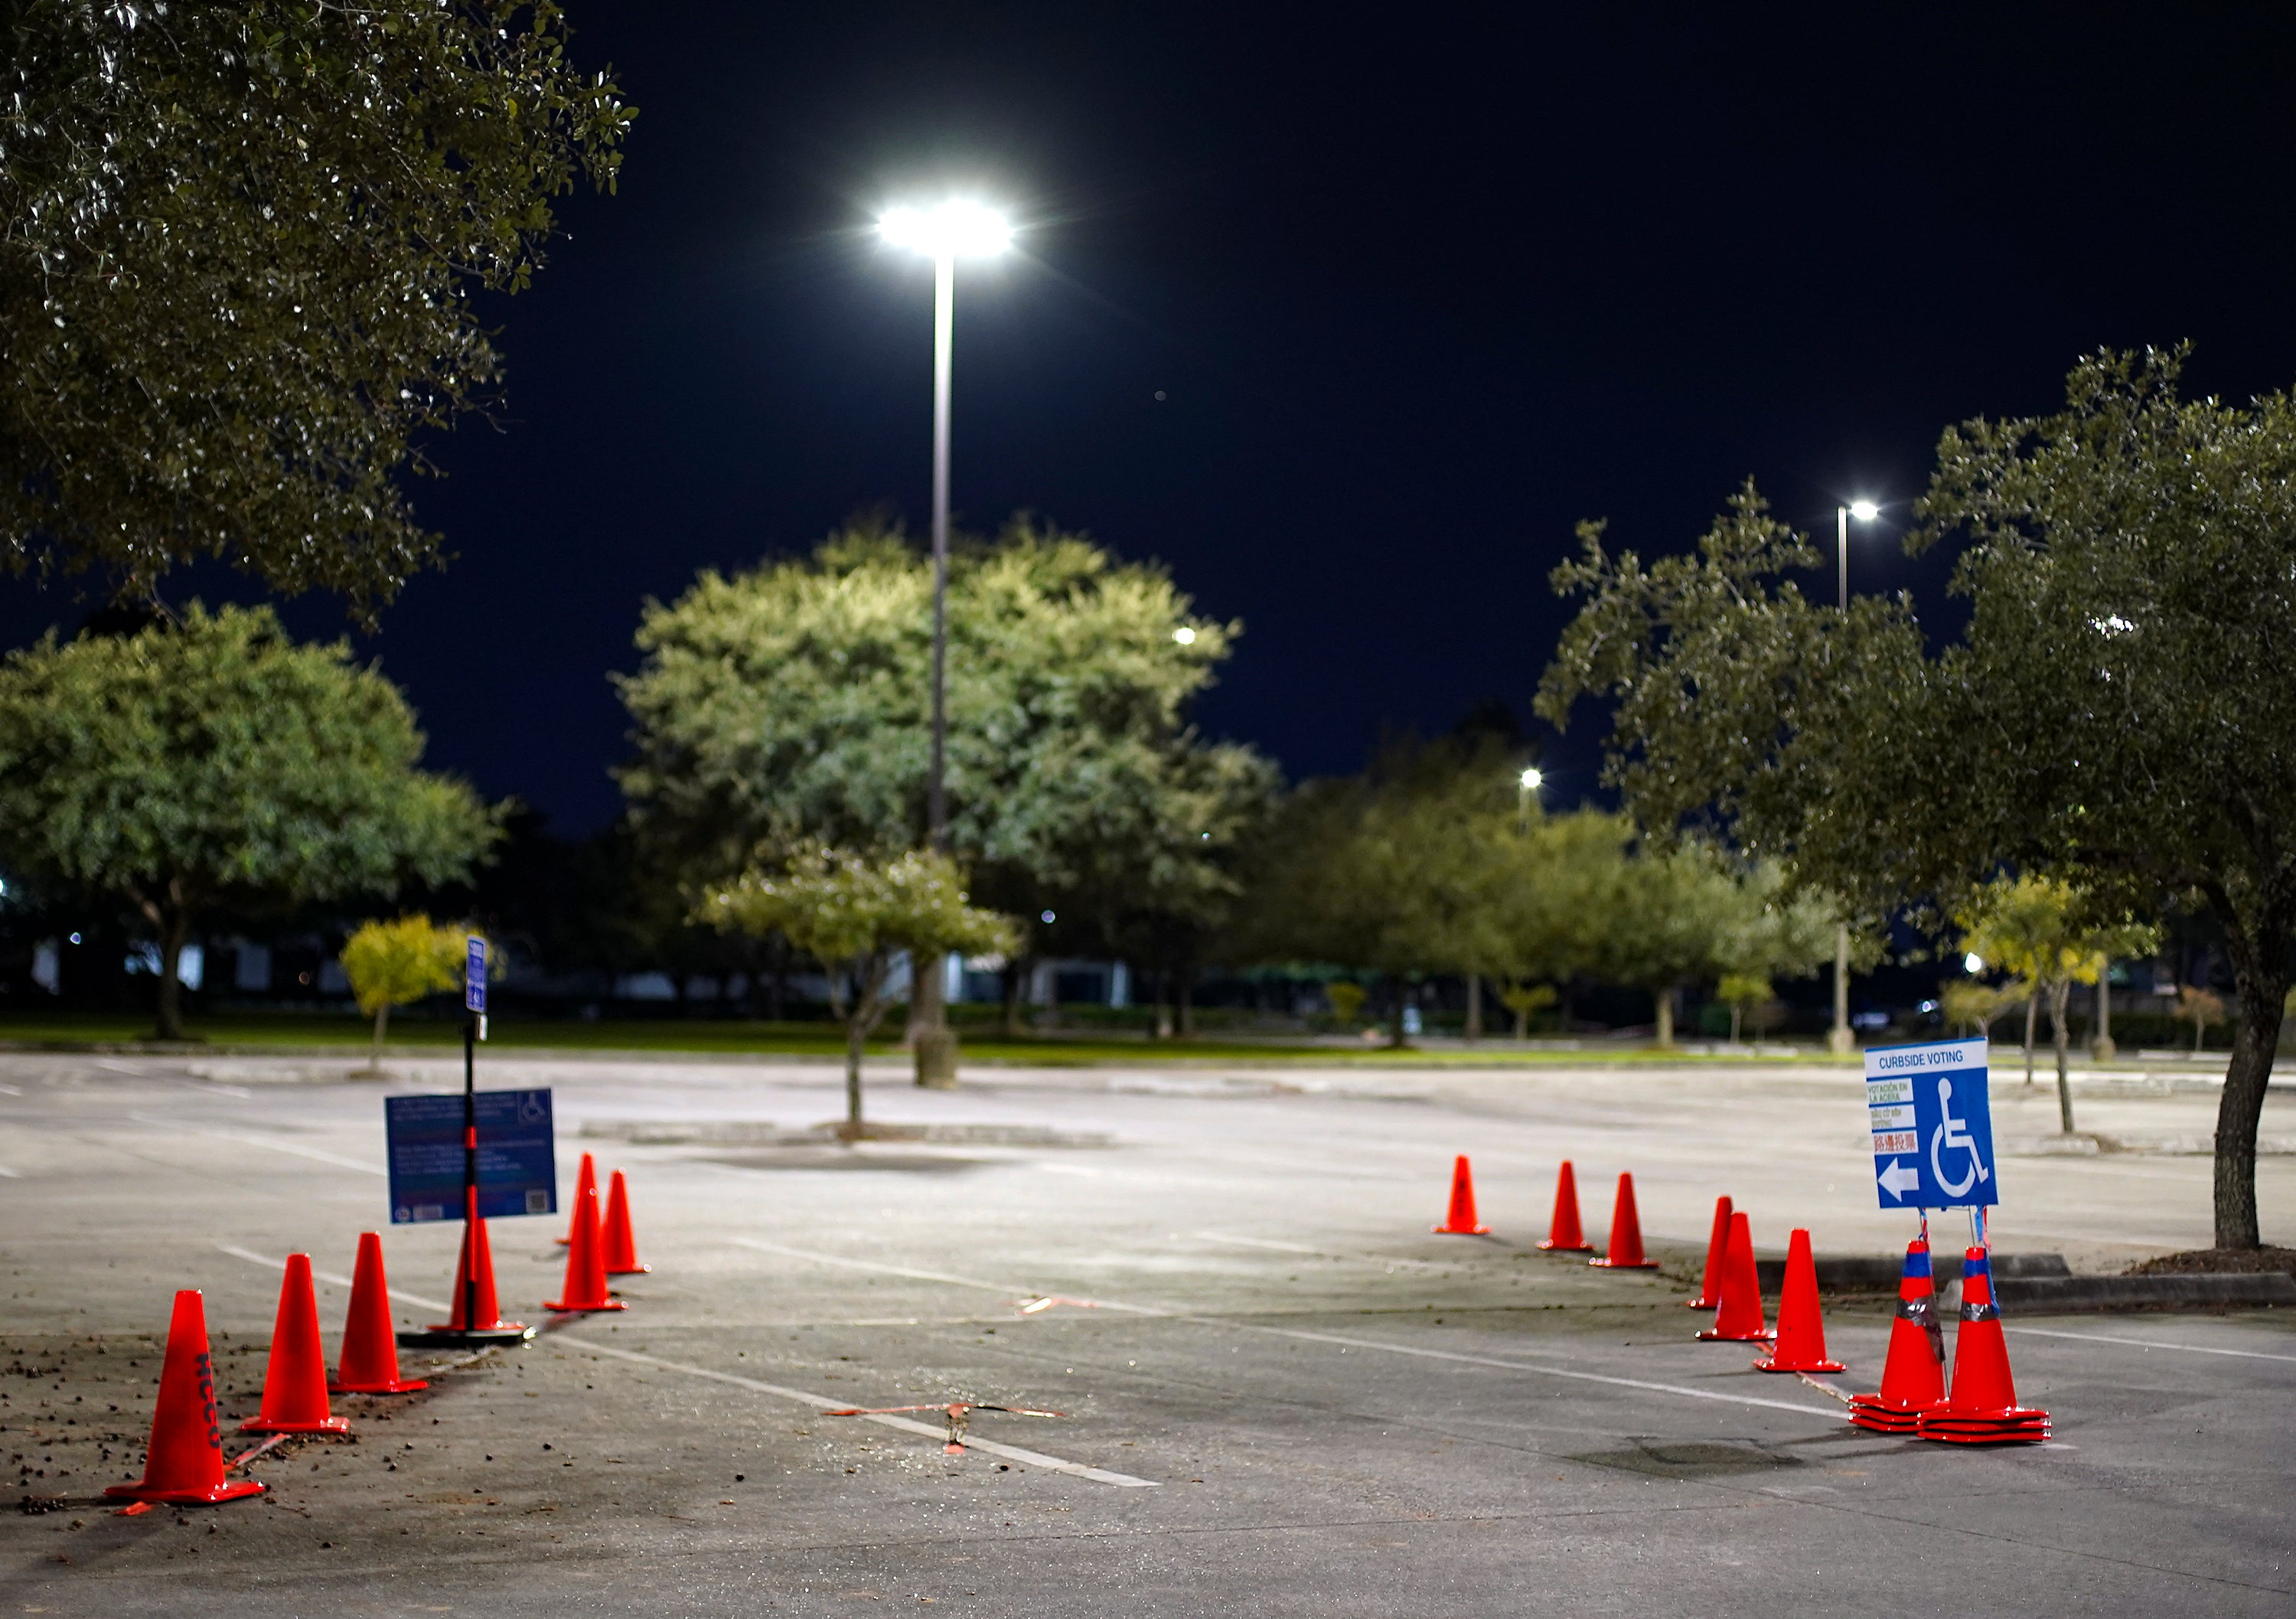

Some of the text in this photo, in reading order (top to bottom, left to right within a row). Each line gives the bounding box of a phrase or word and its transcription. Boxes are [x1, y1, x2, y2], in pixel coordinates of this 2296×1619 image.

[1879, 1050, 1963, 1069] CURBSIDE VOTING
[1867, 1082, 1908, 1094] VOTACIÓN EN
[1870, 1094, 1878, 1103] LA
